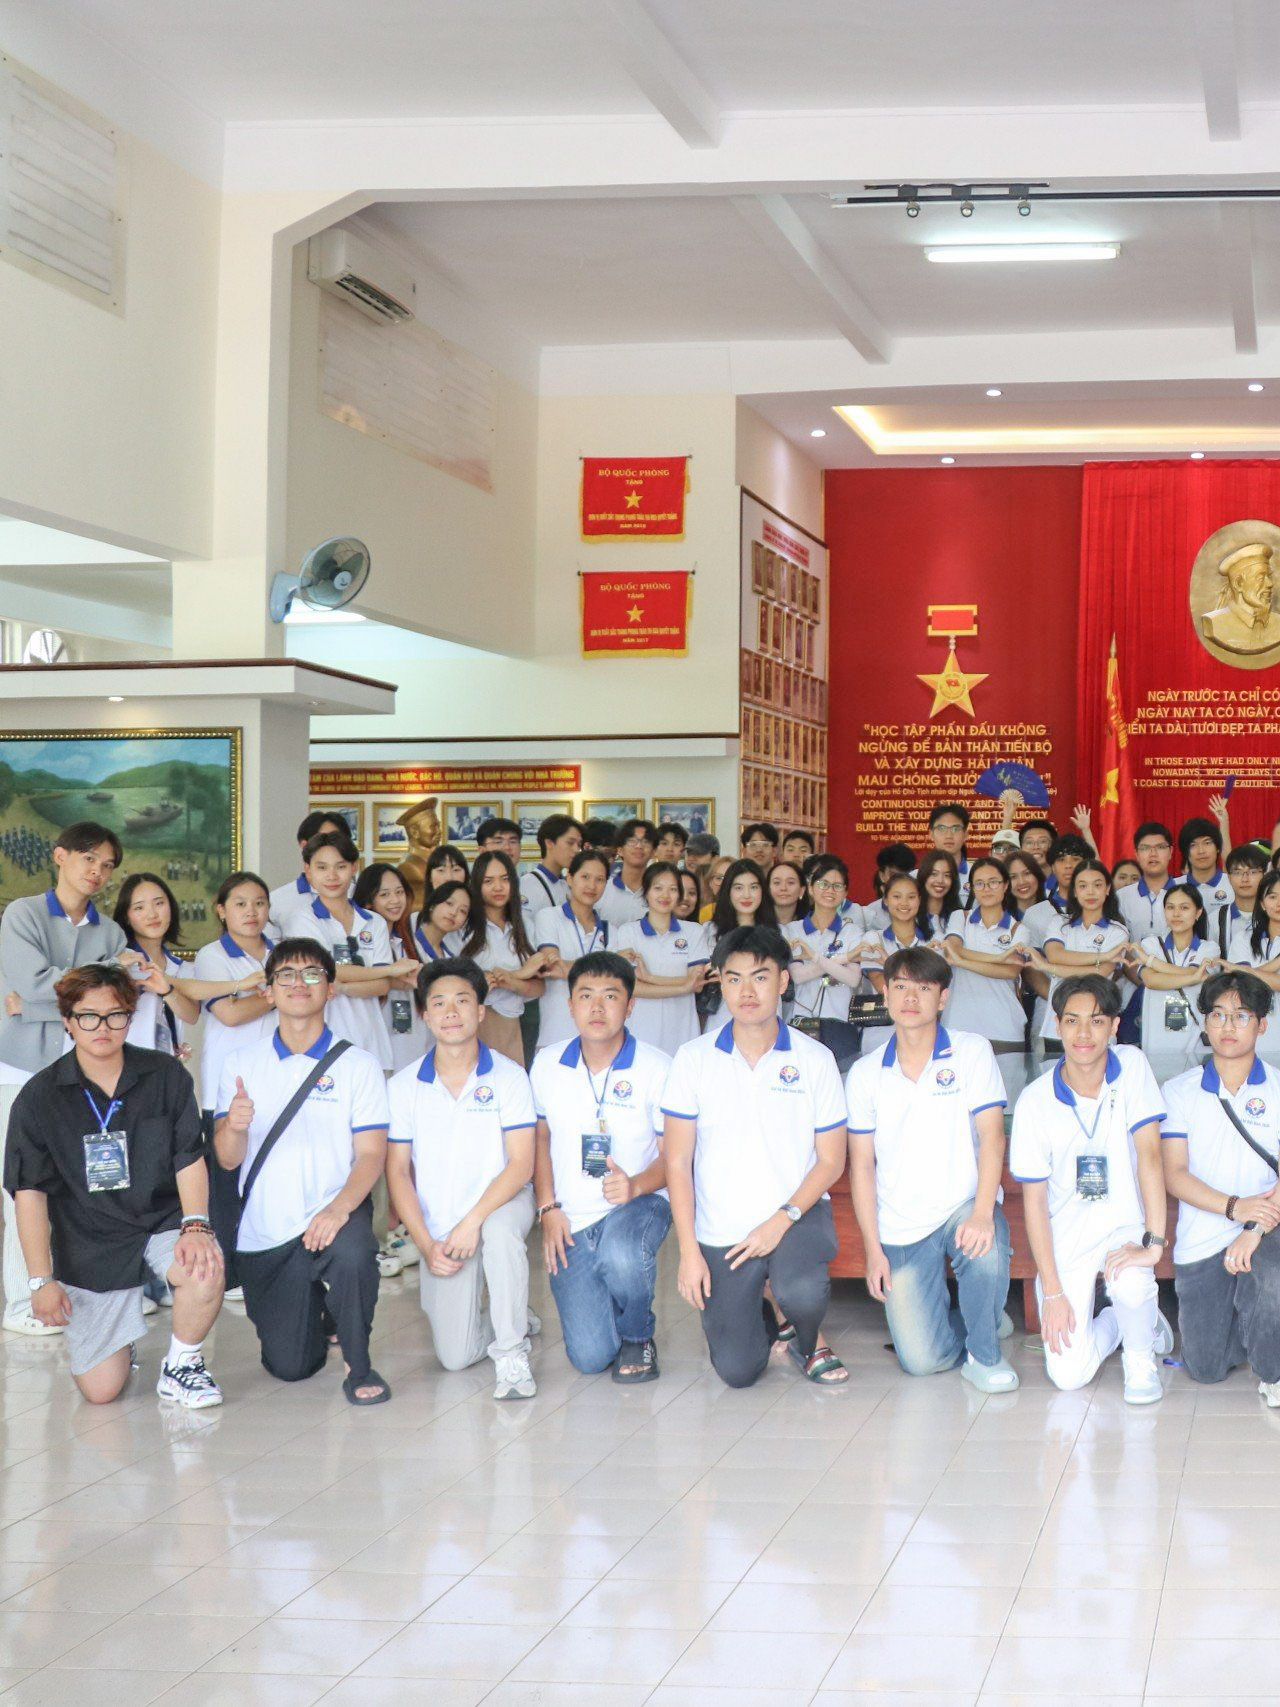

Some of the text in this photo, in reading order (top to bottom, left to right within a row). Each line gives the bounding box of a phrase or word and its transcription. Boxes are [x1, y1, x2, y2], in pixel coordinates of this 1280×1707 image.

[598, 468, 610, 477] BỘ
[612, 468, 637, 477] QUỐC
[1147, 688, 1179, 701] NGÀY
[1183, 688, 1220, 701] TRƯỚC
[1224, 690, 1237, 701] TA
[1240, 686, 1260, 701] CHỈ
[1262, 688, 1280, 701] CÓ
[1137, 704, 1169, 718] NGÀY
[1173, 707, 1197, 718] NAY
[1200, 707, 1213, 718] TA
[1216, 704, 1234, 718] CÓ
[904, 723, 926, 738] TẬP
[930, 721, 965, 736] PHẤN
[969, 721, 996, 736] ĐẤU
[1000, 722, 1047, 736] KHÔNG
[1150, 723, 1163, 734] TA
[1192, 722, 1218, 734] TƯƠI
[1249, 723, 1262, 734] TA
[859, 737, 1053, 756] NGỪNG ĐỂ BẢN THÂN TIẾN BỘ
[874, 754, 991, 772] VÀ XÂY DỰNG HẢI
[1144, 757, 1153, 766] IN
[1155, 757, 1183, 766] THOSE
[1186, 757, 1208, 765] DAYS
[1210, 757, 1224, 765] WE
[1226, 757, 1244, 765] HAD
[1247, 757, 1269, 765] ONLY
[1207, 768, 1219, 776] WE
[858, 770, 981, 786] MAU CHÓNG TRƯỞ
[1140, 778, 1169, 787] COAST
[1171, 778, 1180, 787] IS
[1182, 778, 1205, 787] LONG
[1208, 778, 1225, 787] AND
[1234, 779, 1278, 788] EAUTIFUL,
[862, 800, 936, 809] CONTINUOUSLY
[974, 799, 994, 808] AND
[863, 811, 904, 820] IMPROVE
[971, 811, 991, 820] AND
[1014, 811, 1048, 819] UICKLY
[856, 823, 884, 832] BUILD
[888, 823, 907, 832] THE
